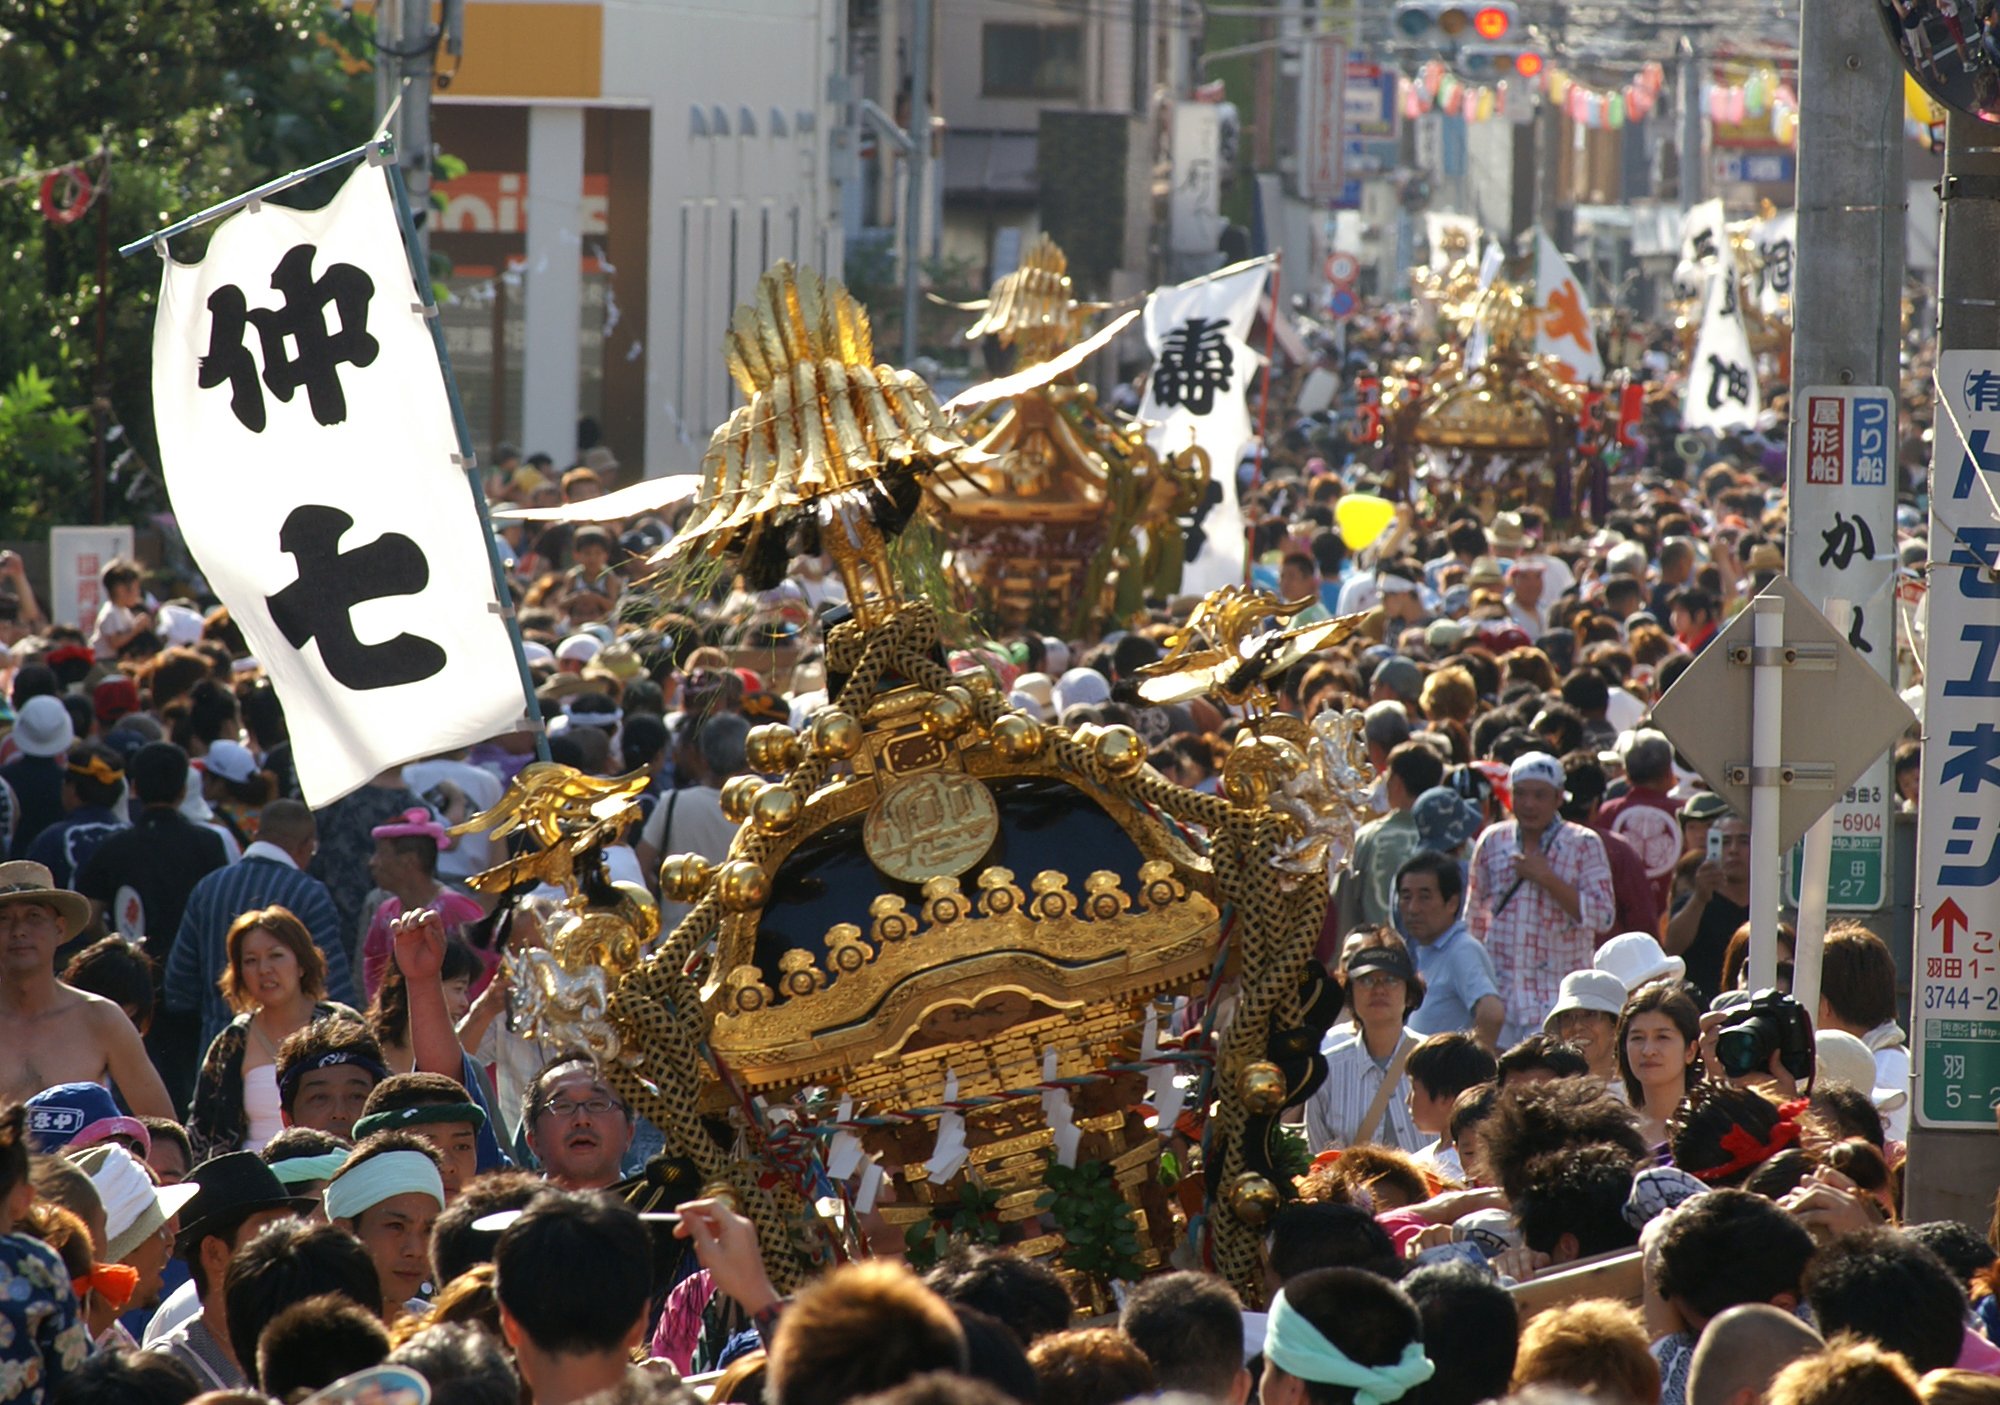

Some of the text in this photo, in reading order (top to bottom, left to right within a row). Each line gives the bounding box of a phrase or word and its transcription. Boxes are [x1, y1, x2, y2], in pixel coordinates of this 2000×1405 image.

[198, 243, 447, 690] 仲七
[1811, 399, 1840, 483] 屋形船
[1856, 403, 1884, 483] つり船
[1850, 860, 1866, 878] 田
[1924, 985, 2000, 1011] 3744-2
[1942, 1054, 1965, 1080] 羽
